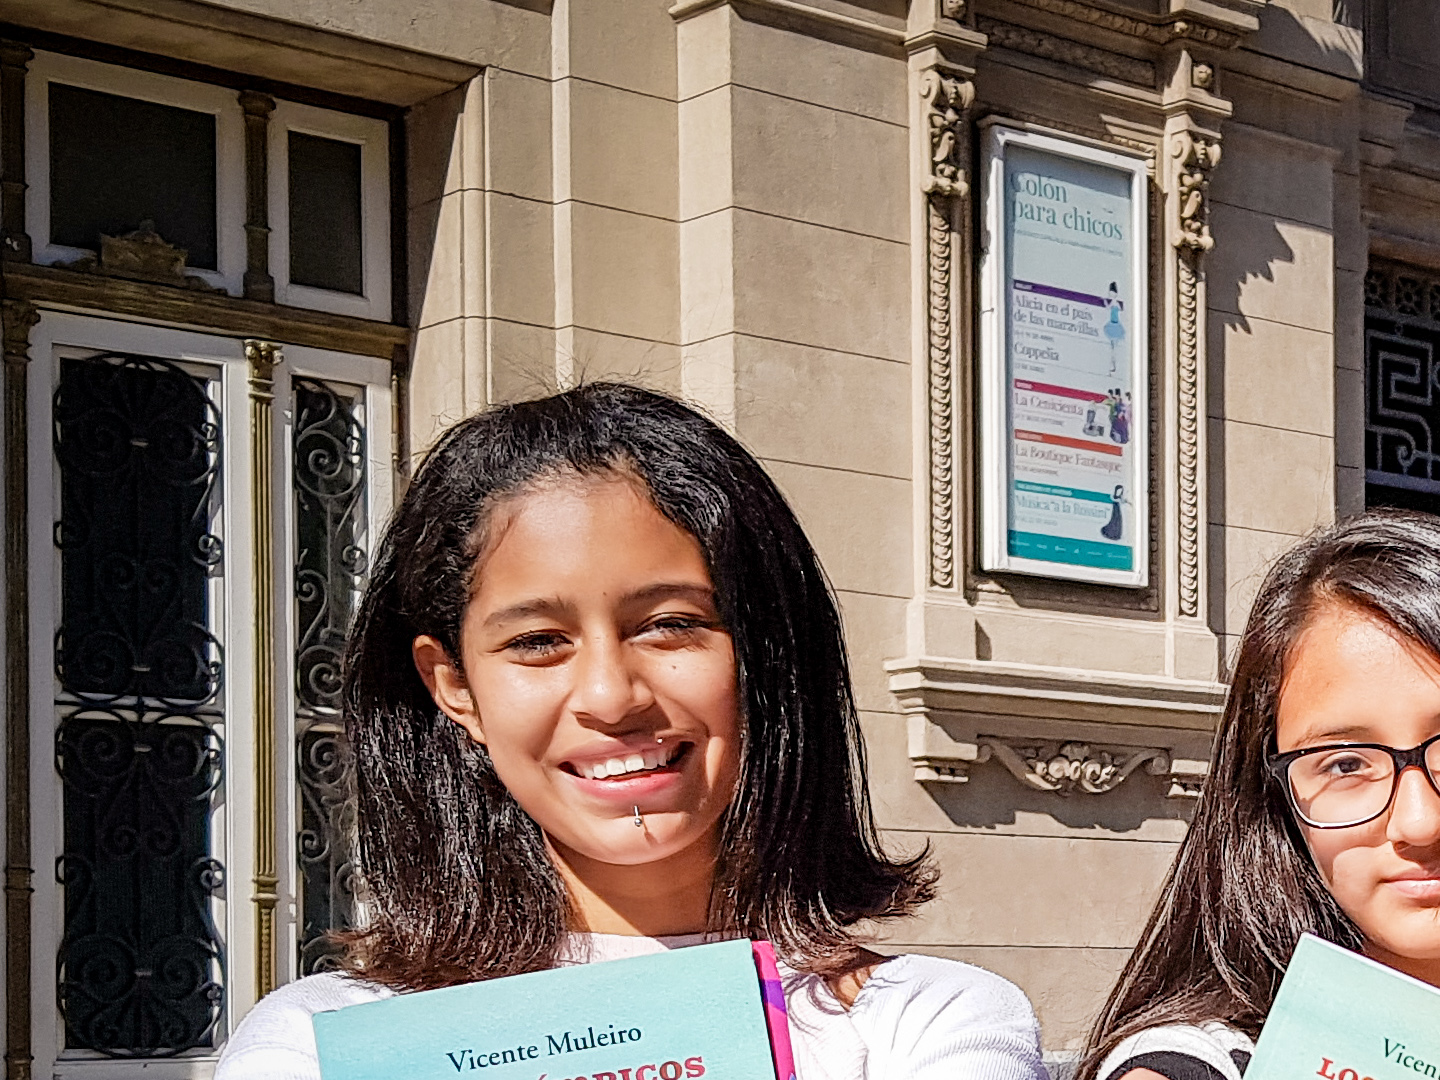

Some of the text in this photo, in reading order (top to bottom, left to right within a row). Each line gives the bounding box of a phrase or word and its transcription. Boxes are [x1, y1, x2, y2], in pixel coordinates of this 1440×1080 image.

[1012, 200, 1123, 241] para chicos
[1029, 310, 1044, 326] las
[1015, 392, 1028, 406] La
[1015, 443, 1028, 457] La
[446, 1024, 642, 1073] Vicente Muleiro
